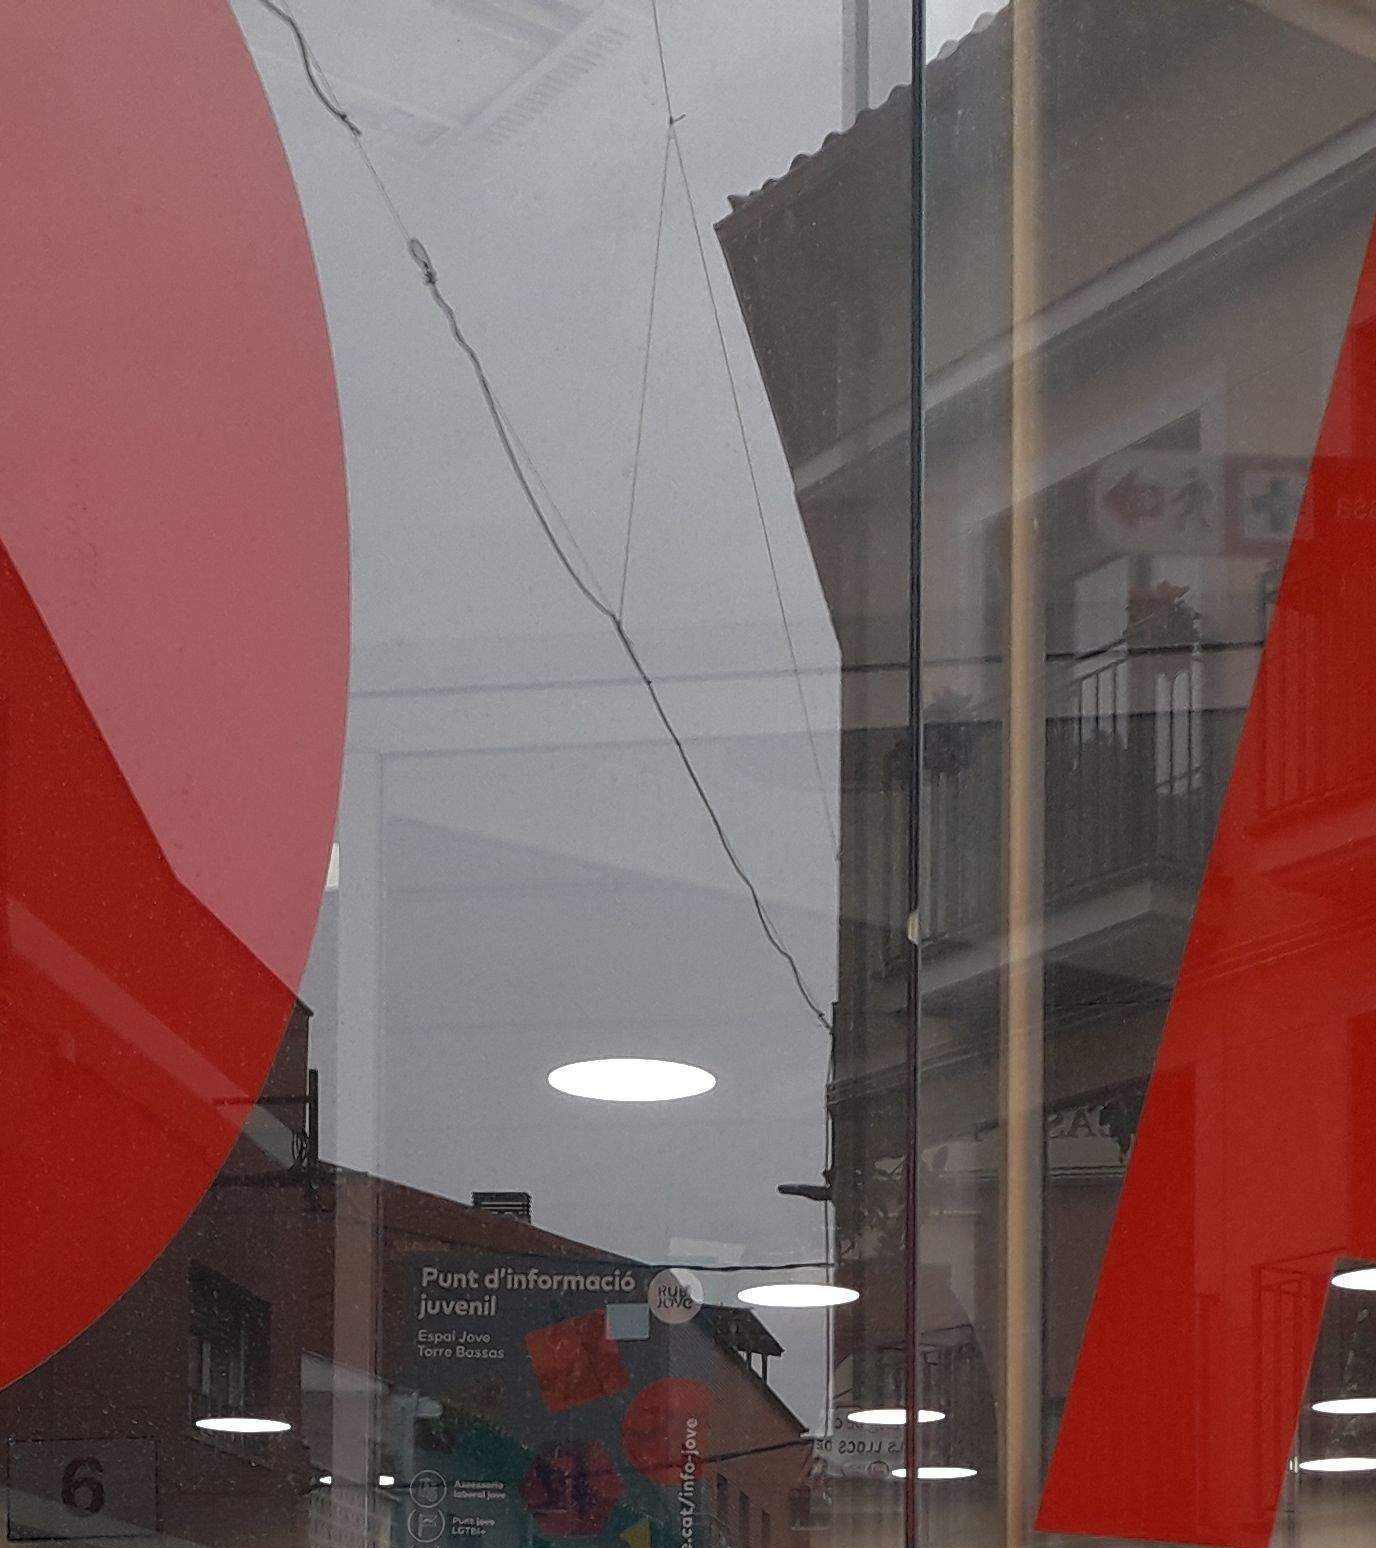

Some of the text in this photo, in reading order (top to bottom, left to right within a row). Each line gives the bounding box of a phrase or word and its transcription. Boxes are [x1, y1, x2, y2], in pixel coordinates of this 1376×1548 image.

[421, 1267, 635, 1293] Punt d'informació
[417, 1293, 496, 1319] juvenil
[417, 1329, 490, 1344] Espai Jove
[417, 1344, 504, 1359] Torre Bassas
[61, 1456, 106, 1517] 6
